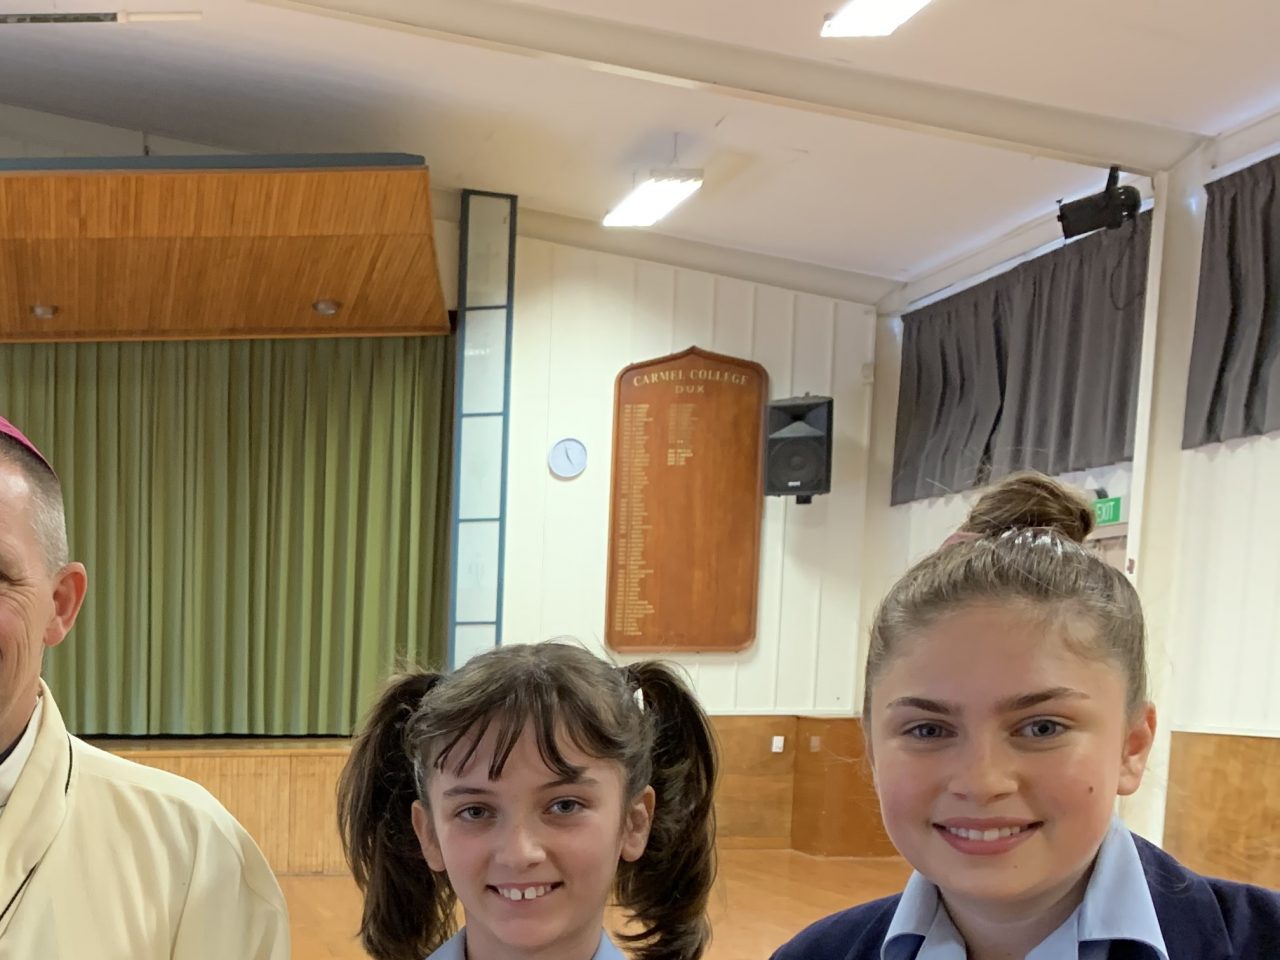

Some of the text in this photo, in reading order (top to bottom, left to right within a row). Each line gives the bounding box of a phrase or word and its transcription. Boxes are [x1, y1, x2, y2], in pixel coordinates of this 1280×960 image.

[633, 369, 749, 386] CARMEL COLLEGE
[675, 385, 704, 394] DUX
